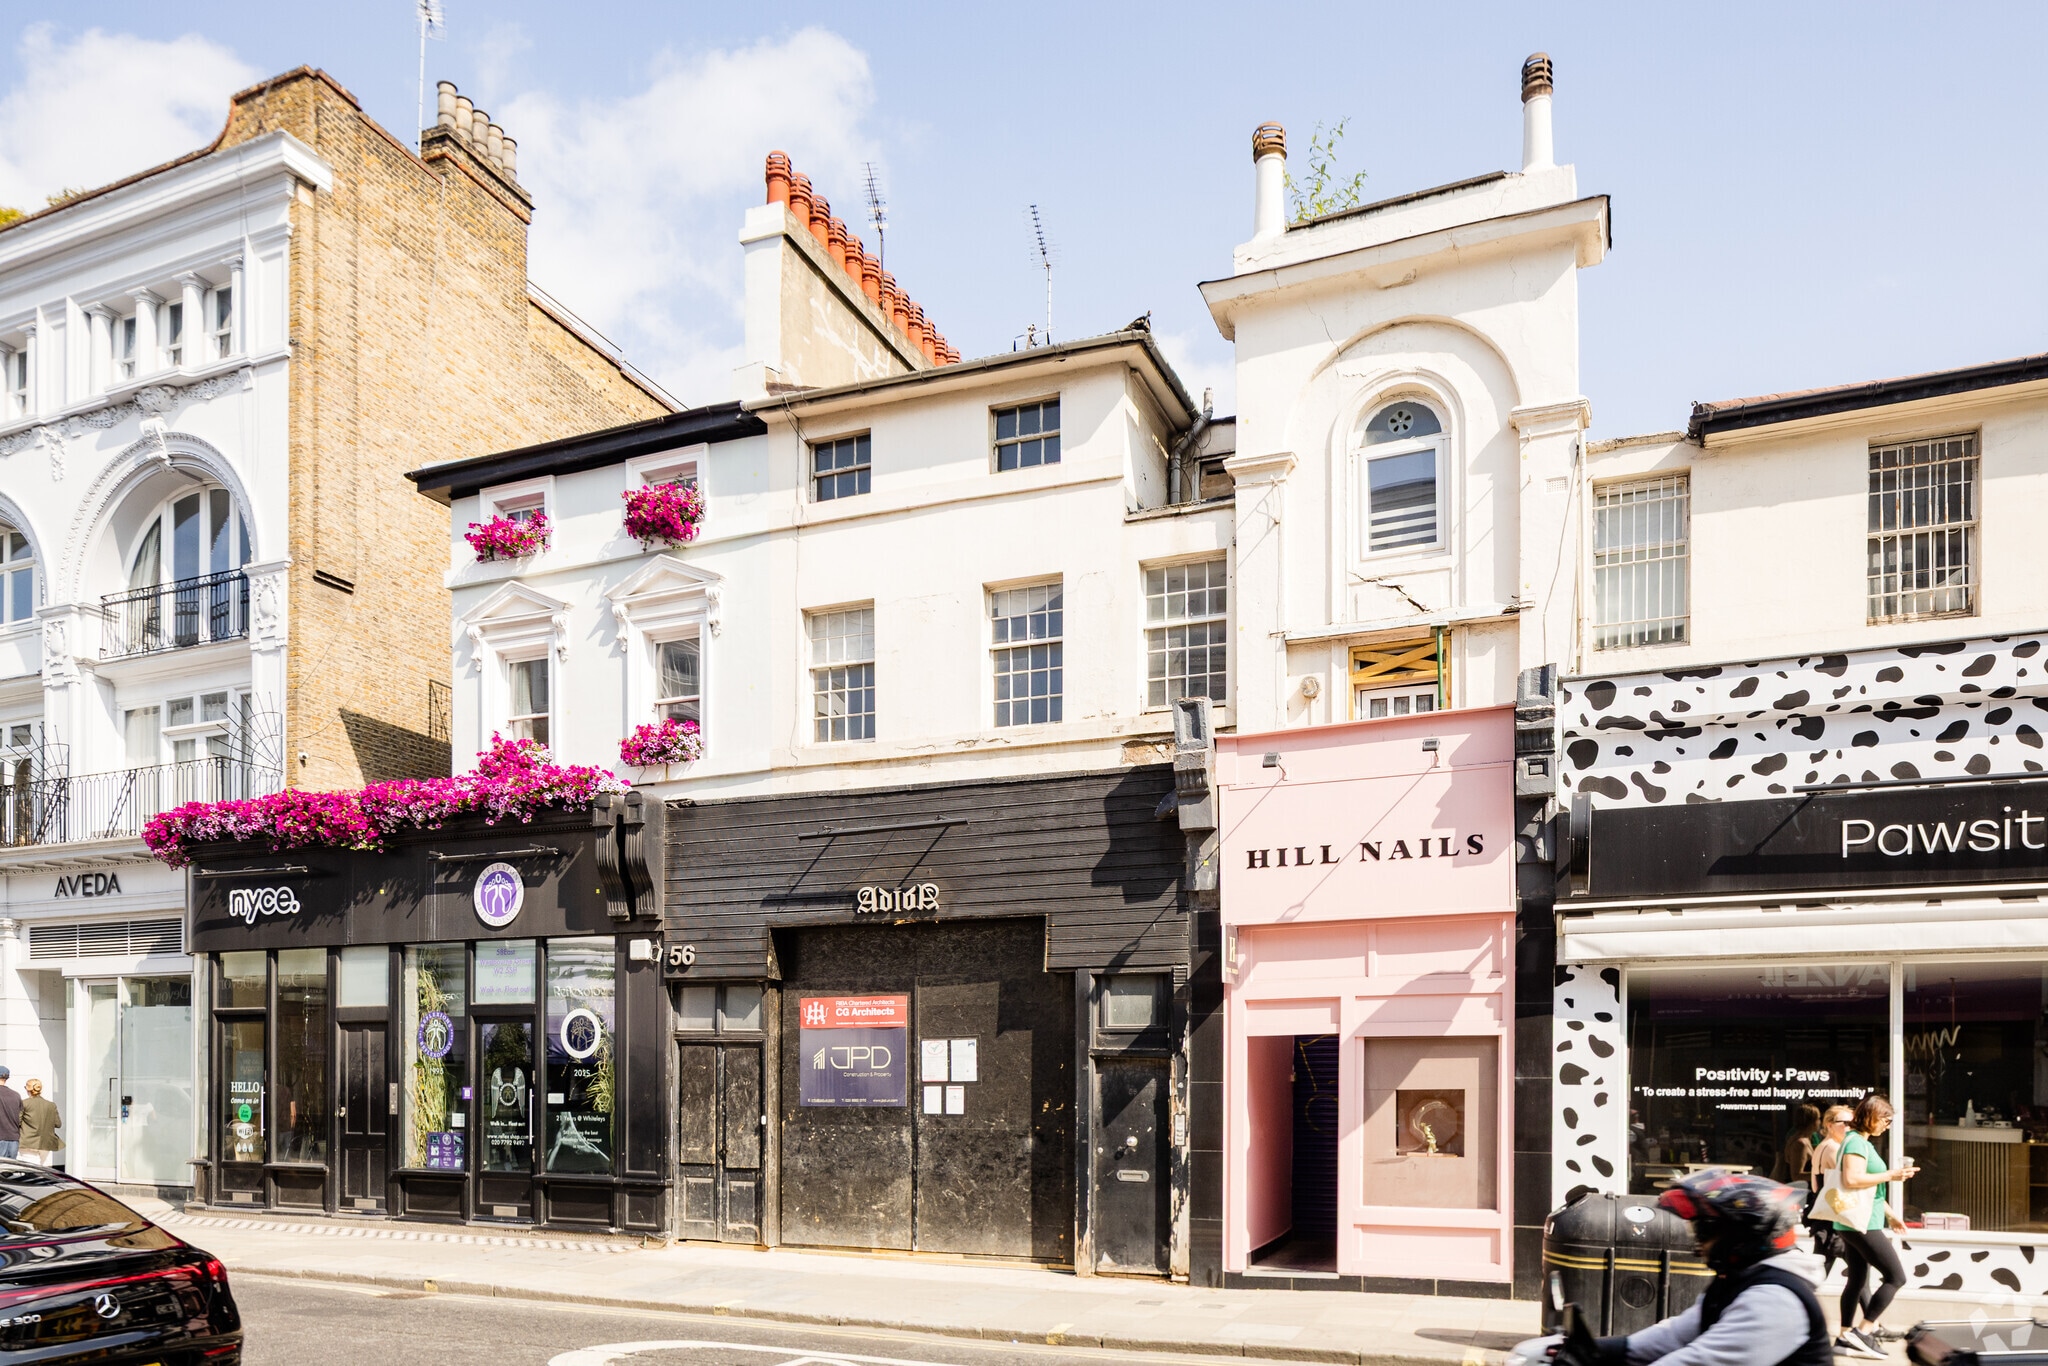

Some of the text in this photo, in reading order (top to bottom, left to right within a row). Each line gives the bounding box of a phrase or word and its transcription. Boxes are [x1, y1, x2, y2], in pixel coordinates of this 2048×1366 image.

[1842, 806, 2045, 858] Pawsit
[1246, 834, 1484, 869] HILL NAILS
[54, 872, 121, 898] AVEDA
[229, 886, 300, 924] nyce.
[670, 945, 695, 966] 56
[835, 1006, 896, 1017] CG Architects
[830, 1046, 891, 1069] JPD
[1695, 1067, 1830, 1084] Positivity + Paws
[230, 1081, 260, 1093] HELLO
[1642, 1086, 1655, 1097] To
[1656, 1087, 1686, 1097] create
[1688, 1088, 1695, 1097] a
[1696, 1087, 1750, 1097] stress-free
[1751, 1087, 1771, 1097] and
[1773, 1087, 1805, 1099] happy
[1808, 1087, 1866, 1100] community
